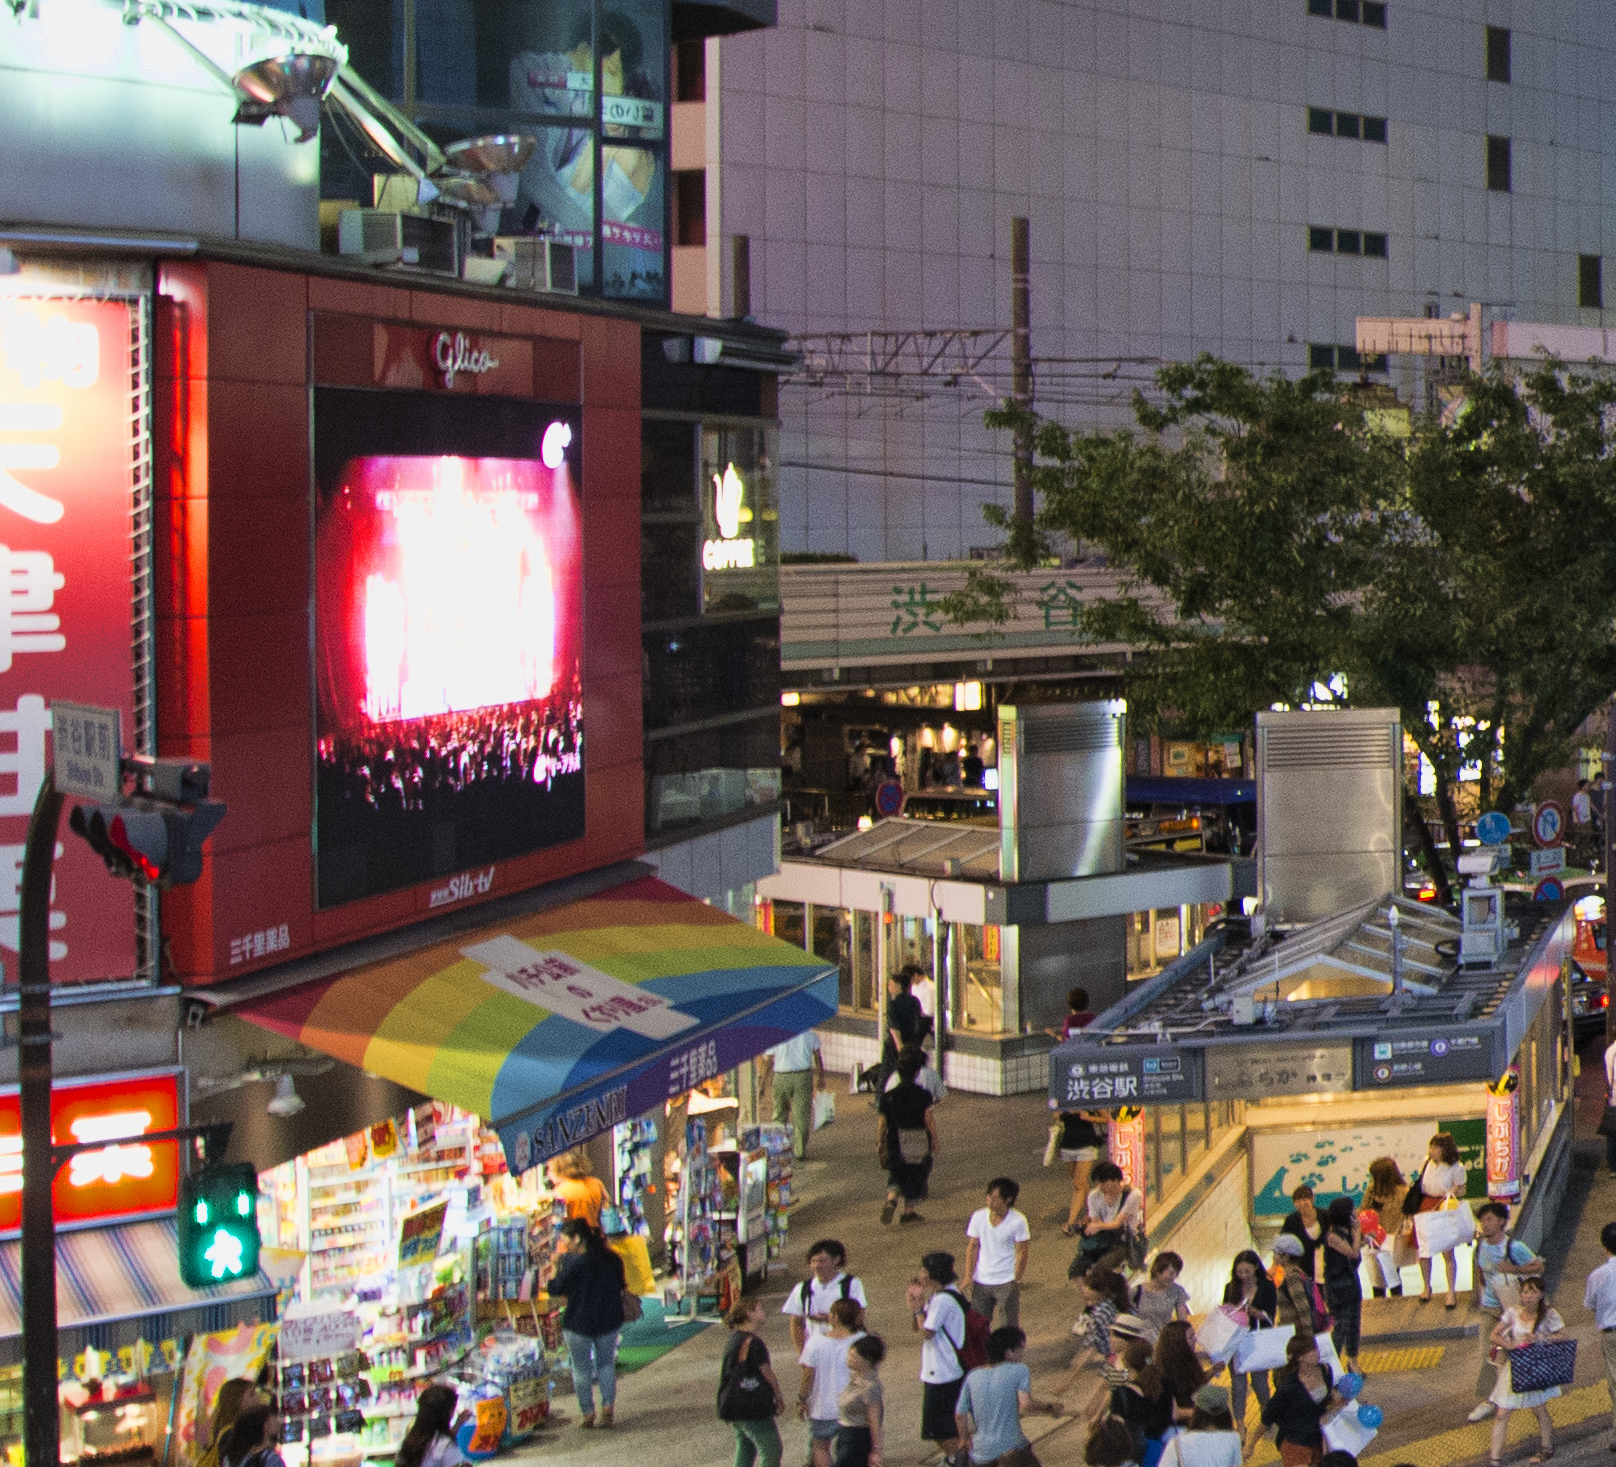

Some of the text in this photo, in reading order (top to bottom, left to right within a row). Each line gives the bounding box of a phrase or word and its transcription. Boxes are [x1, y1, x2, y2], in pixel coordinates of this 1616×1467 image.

[436, 332, 500, 388] Glico
[703, 538, 755, 571] COFFEE
[229, 923, 291, 966] 三千里薬品
[668, 1038, 719, 1095] 三千里薬品
[1066, 1075, 1138, 1101] 渋谷駅
